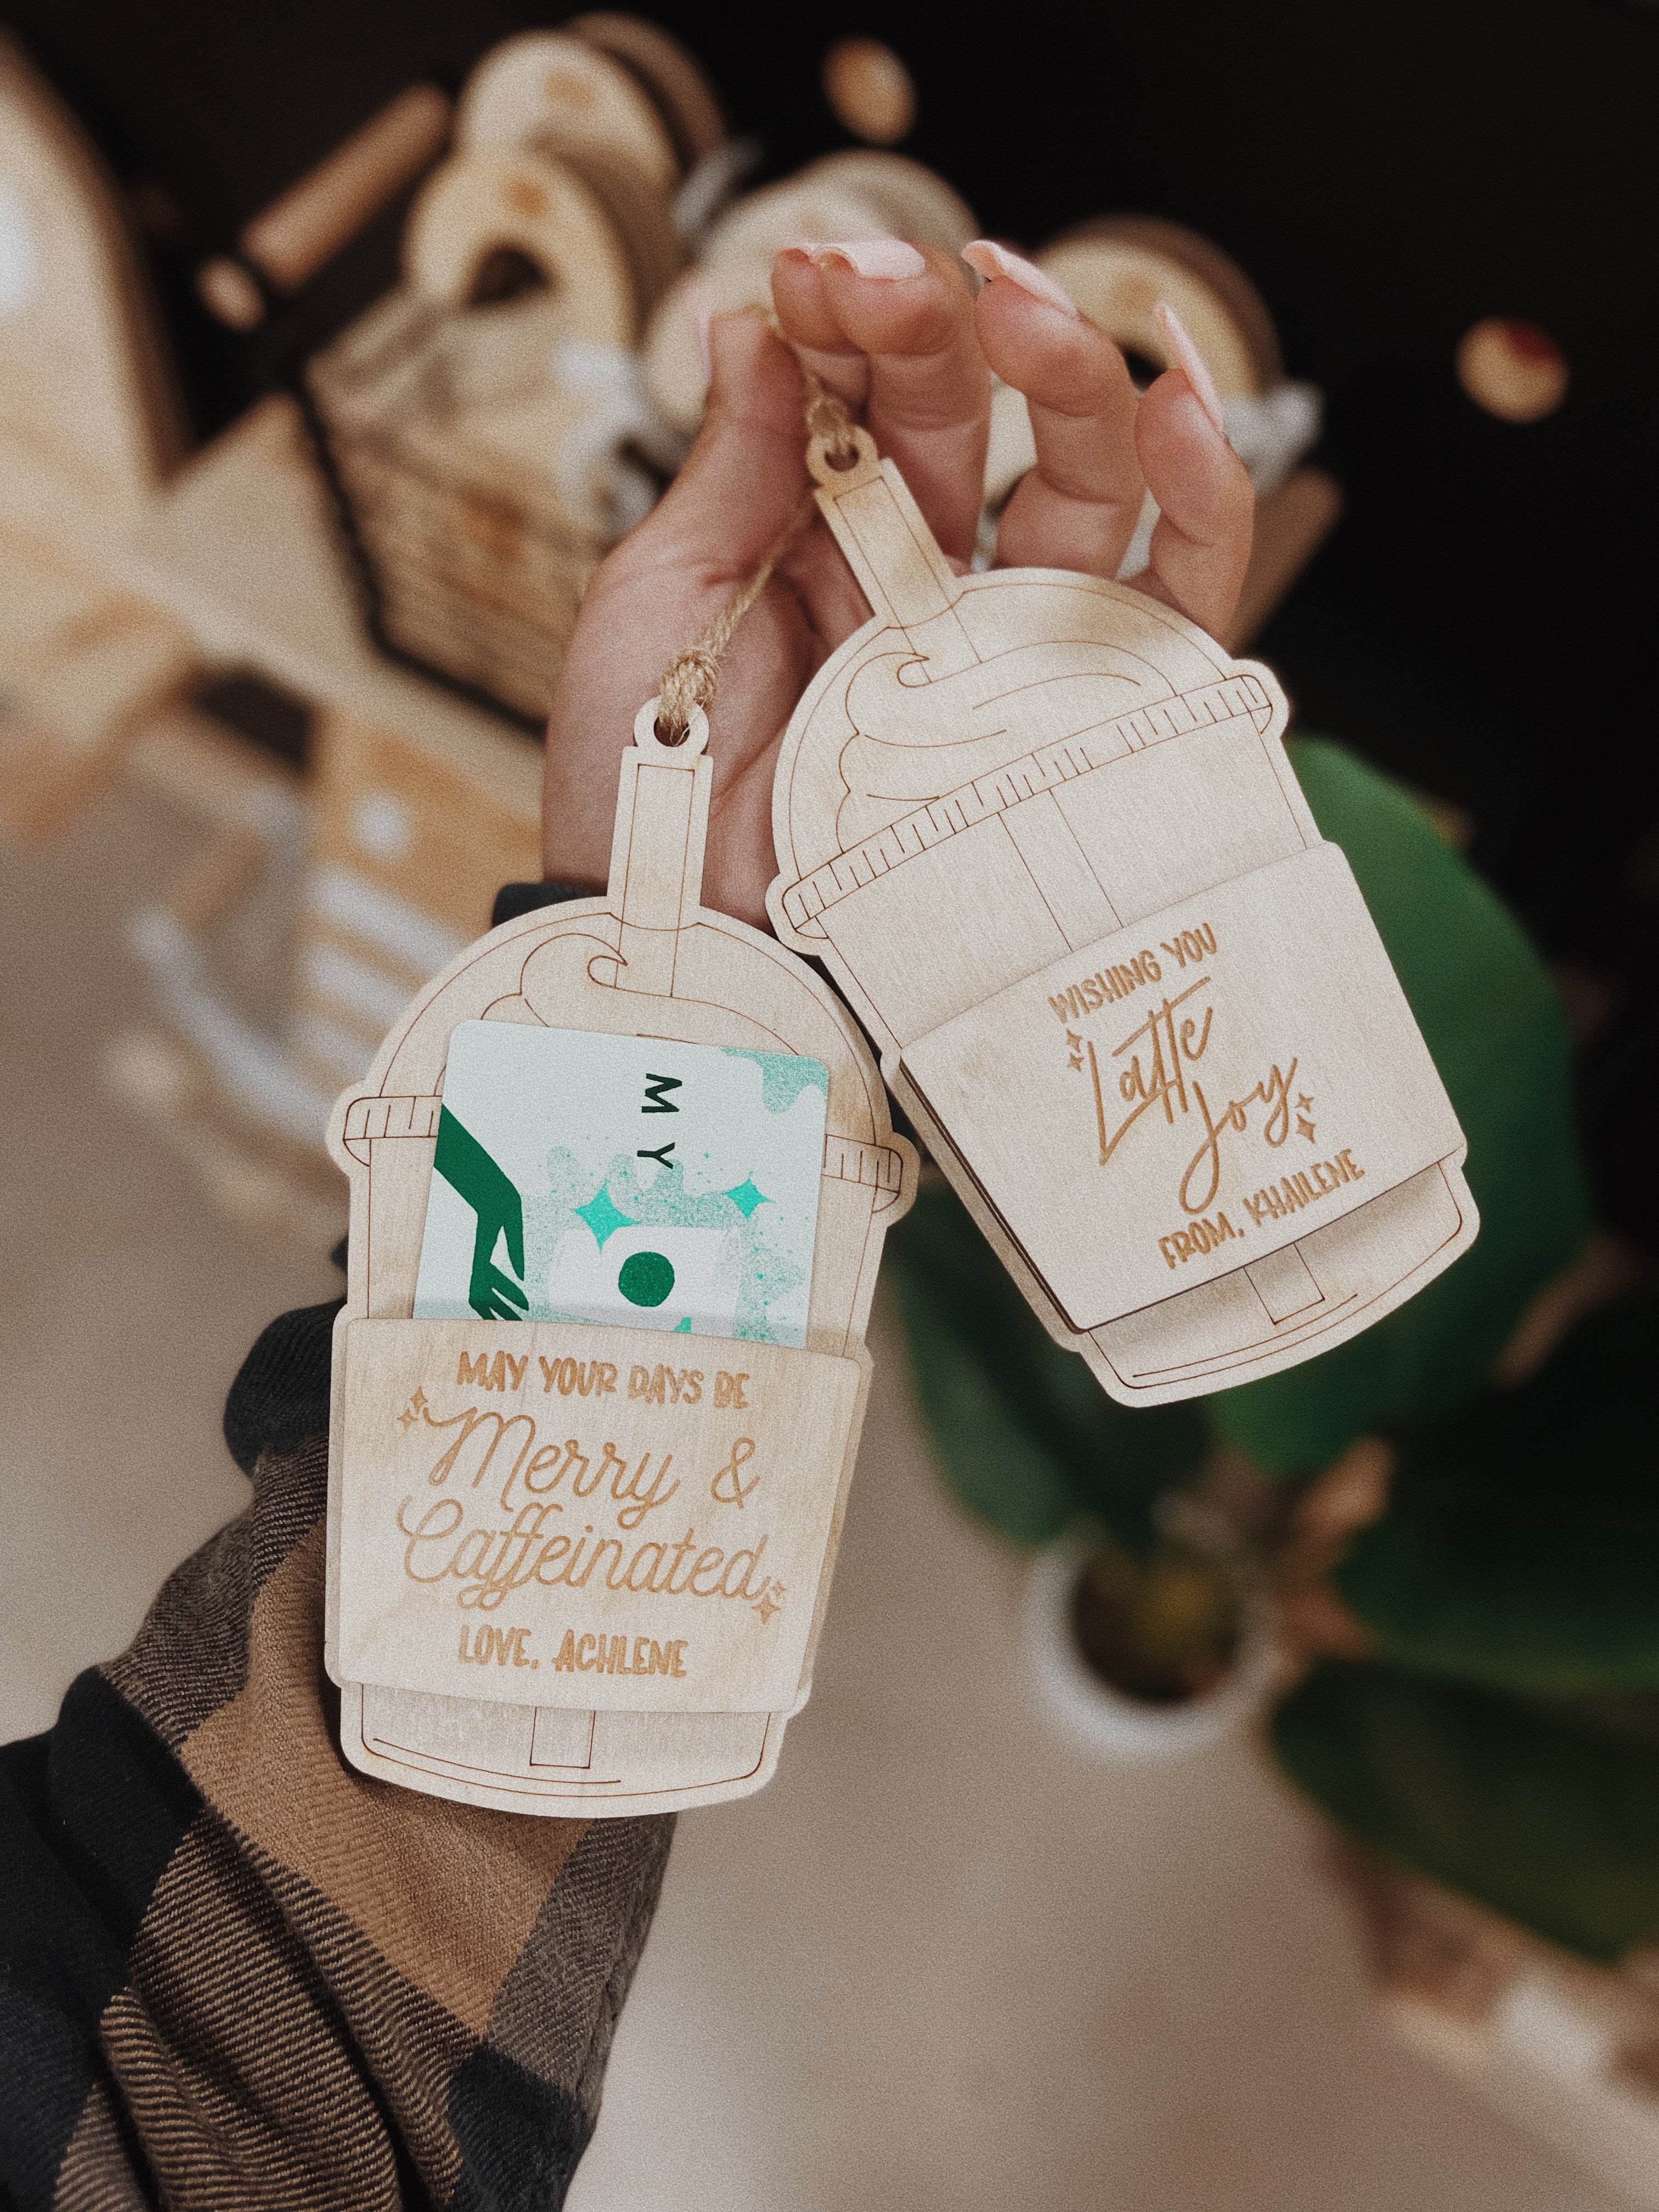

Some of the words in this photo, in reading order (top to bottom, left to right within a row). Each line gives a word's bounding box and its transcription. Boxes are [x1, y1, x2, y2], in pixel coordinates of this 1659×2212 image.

[1048, 950, 1161, 1023] WISHING
[1160, 922, 1217, 967] YOU
[1088, 976, 1213, 1166] Latte
[1178, 1057, 1298, 1215] Joy
[1242, 1148, 1365, 1227] KHAILENE
[457, 1351, 528, 1391] MAY
[539, 1356, 618, 1396] YOUR
[628, 1364, 704, 1404] DAYS
[714, 1372, 749, 1409] BE
[424, 1407, 680, 1530] Merry
[711, 1437, 760, 1509] &
[397, 1495, 772, 1610] Caffeinated
[552, 1629, 689, 1678] ACHLENE
